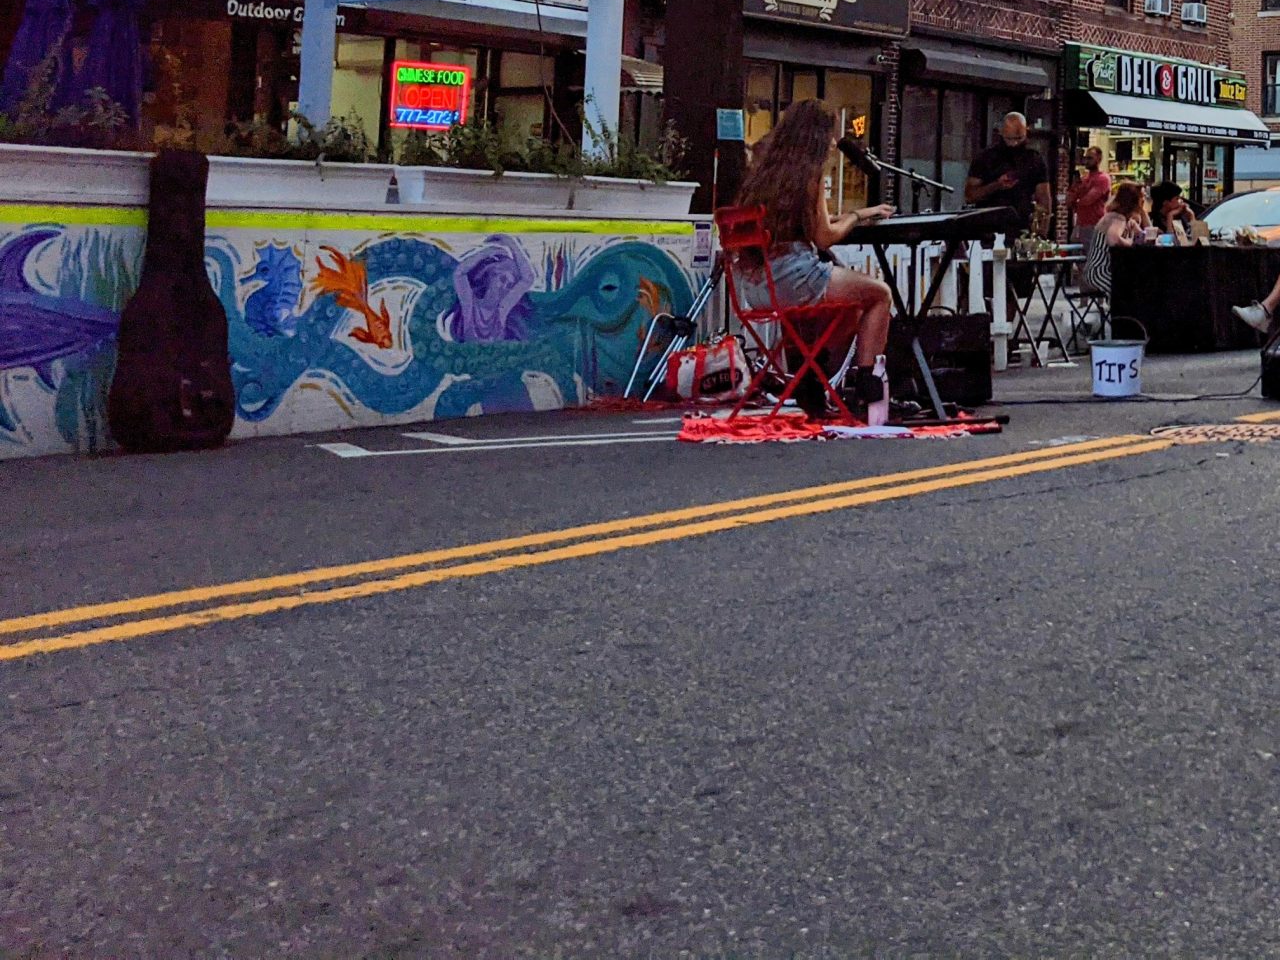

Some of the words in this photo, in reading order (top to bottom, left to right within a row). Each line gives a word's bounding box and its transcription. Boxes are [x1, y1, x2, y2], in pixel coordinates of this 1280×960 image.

[227, 0, 290, 20] Outdoor
[397, 67, 435, 83] CHINESE
[436, 69, 465, 86] FOOD
[1121, 56, 1155, 94] DELI
[1177, 66, 1217, 104] GRILL
[405, 86, 456, 110] OPEN
[1095, 359, 1138, 383] TIPS
